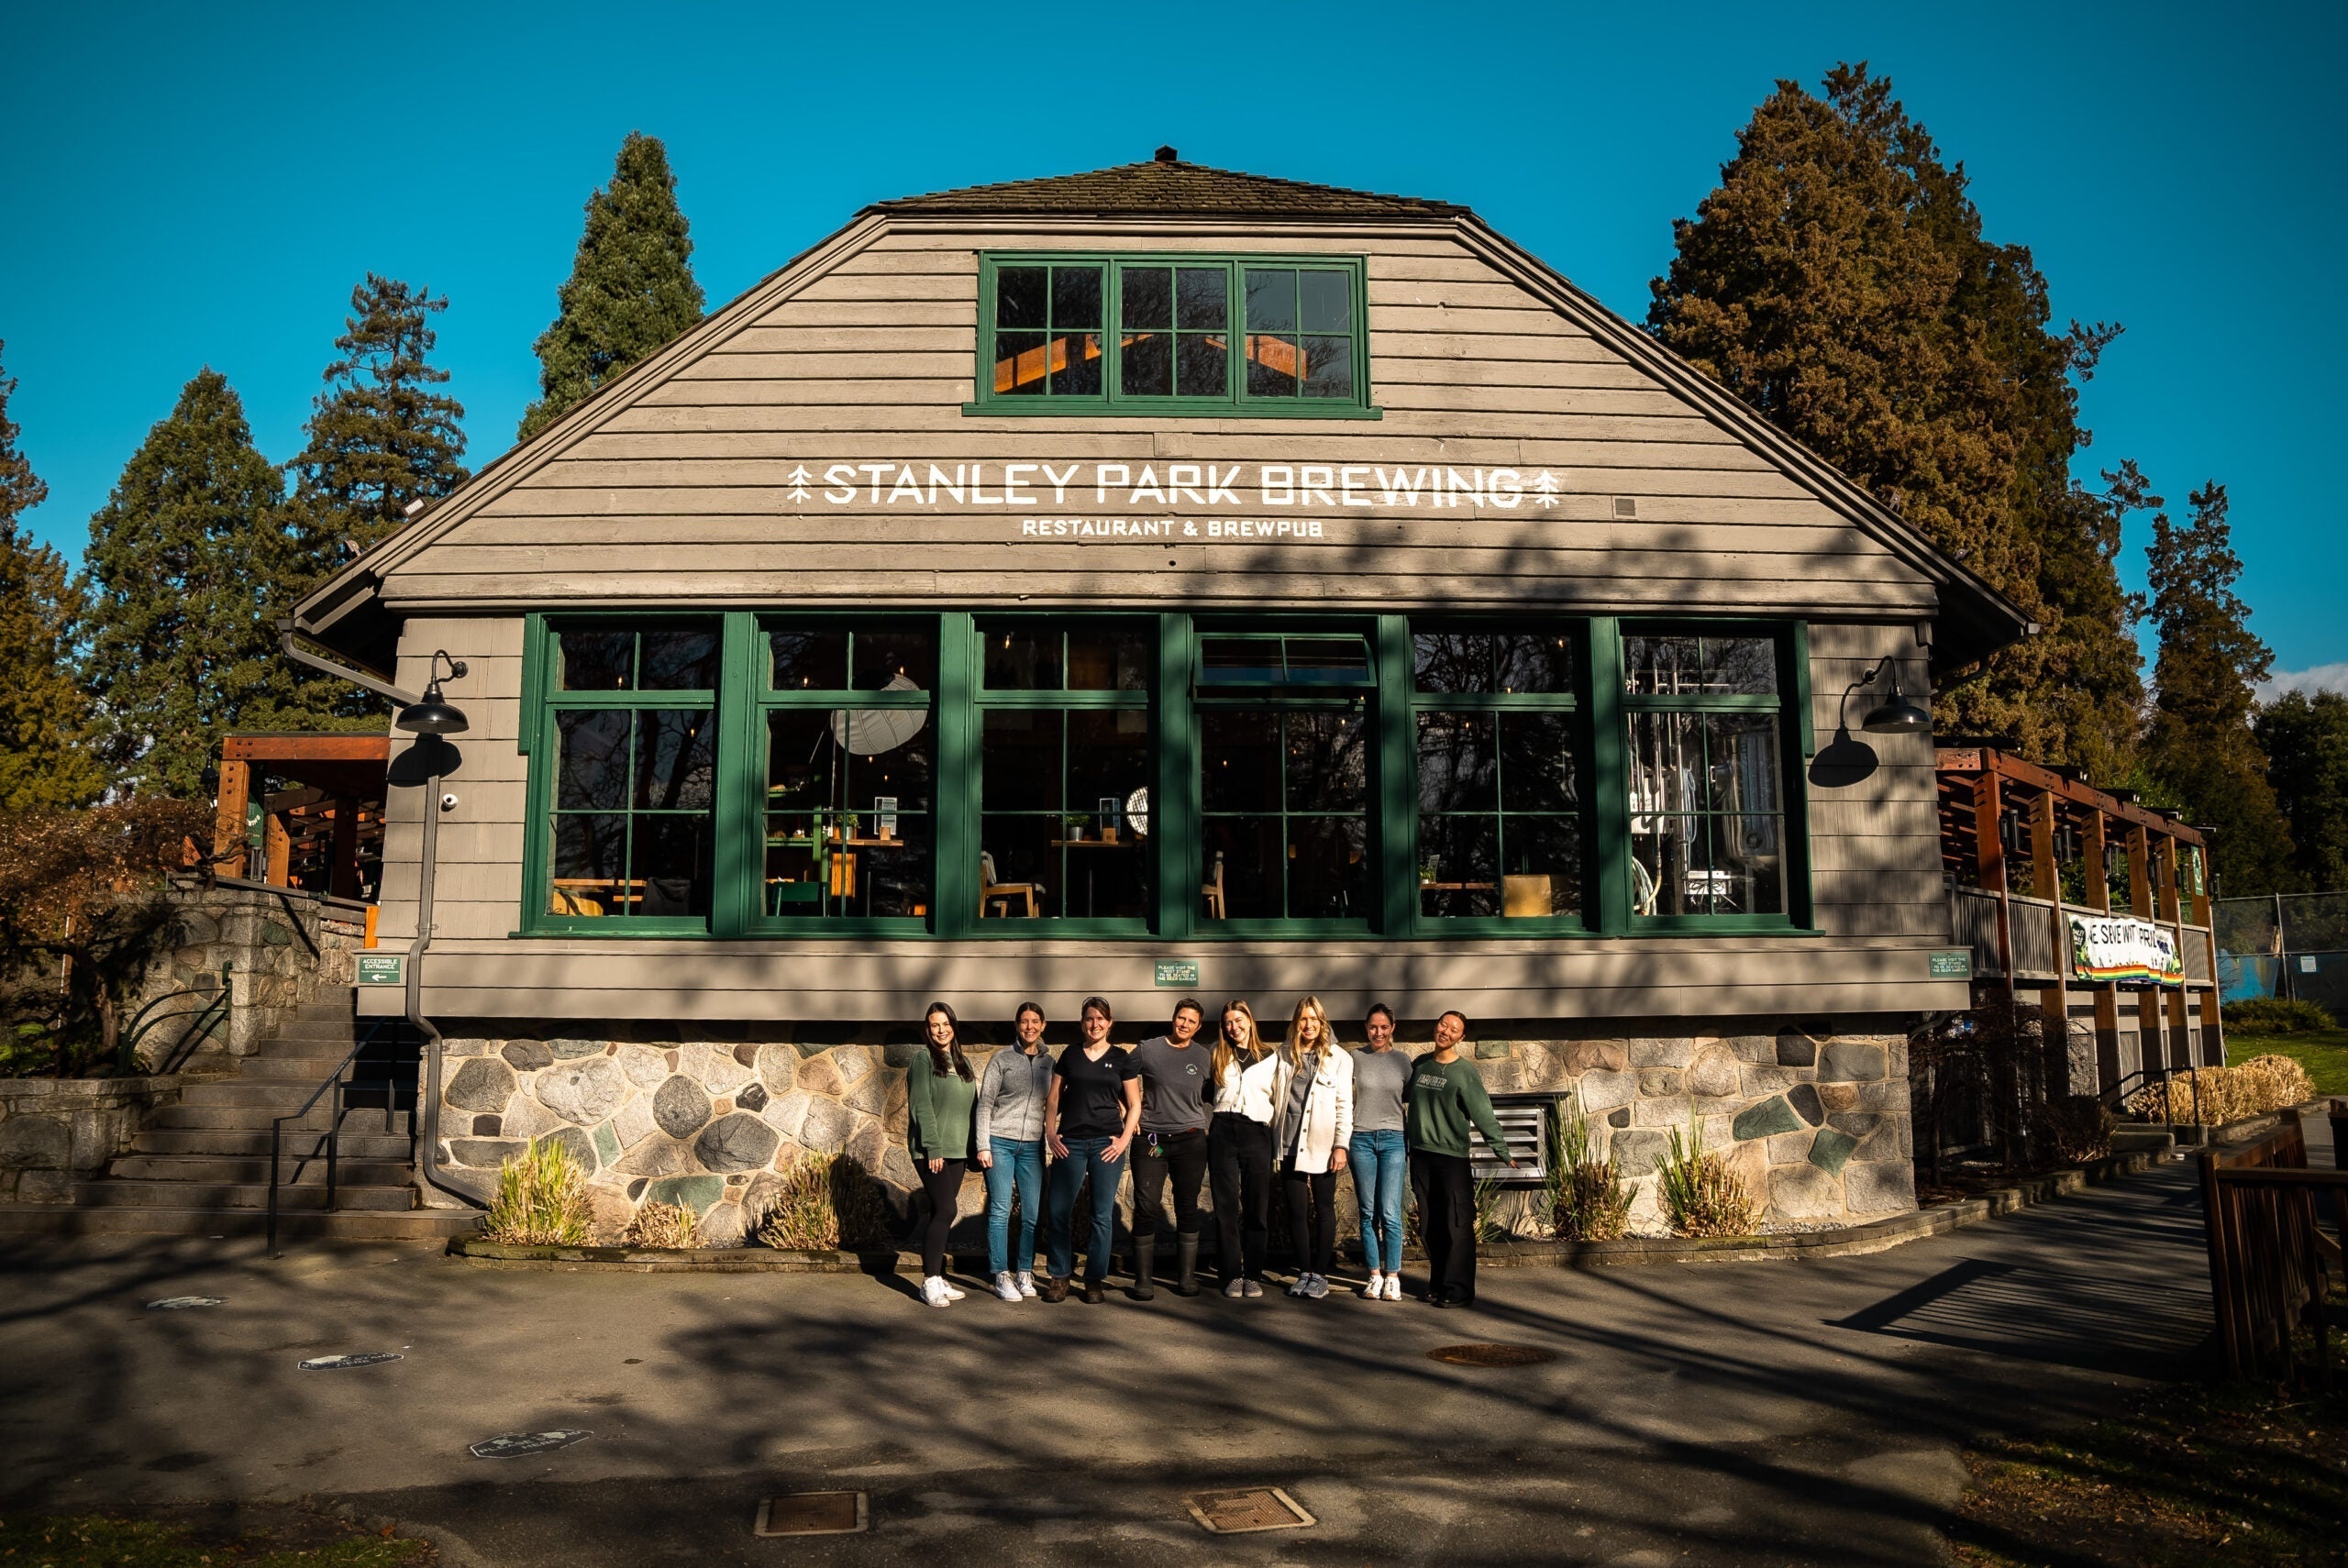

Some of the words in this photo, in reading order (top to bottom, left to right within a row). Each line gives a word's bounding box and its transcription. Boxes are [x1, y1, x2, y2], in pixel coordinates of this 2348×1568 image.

[824, 464, 1080, 504] STANLEY
[1097, 465, 1242, 505] PARK
[1261, 466, 1523, 509] BREWING
[1023, 519, 1175, 536] RESTAURANT
[1183, 520, 1198, 536] &
[1208, 521, 1324, 537] BREWPUB
